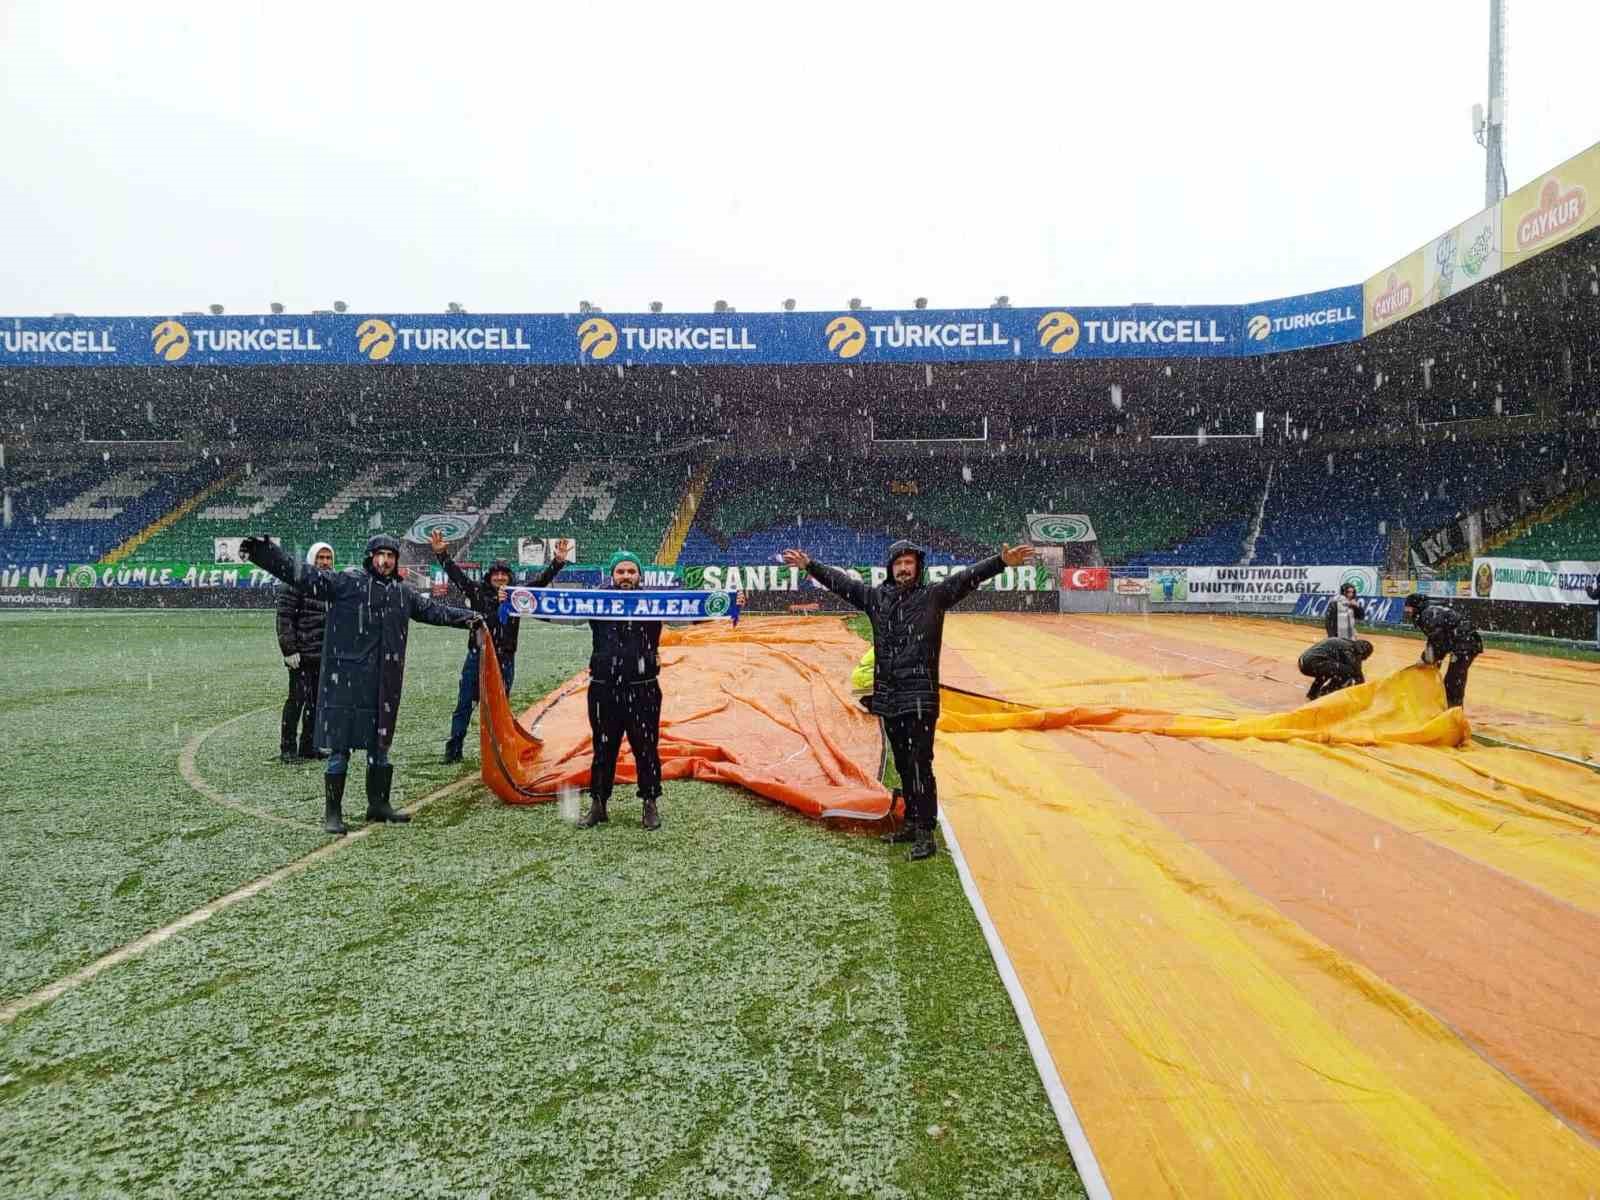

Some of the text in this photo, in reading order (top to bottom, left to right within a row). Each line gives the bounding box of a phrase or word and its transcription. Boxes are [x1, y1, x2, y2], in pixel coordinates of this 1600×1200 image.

[1271, 306, 1356, 331] TURKCELL
[0, 331, 116, 352] URKCELL
[193, 328, 322, 352] TURKCELL
[397, 328, 531, 351] TURKCELL
[622, 327, 756, 351] TURKCELL
[870, 323, 1009, 347] TURKCELL
[1084, 319, 1226, 344] TURKCELL
[1216, 568, 1309, 580] UNUTMADIK
[541, 592, 625, 616] CÜMLE
[633, 598, 700, 616] ALEM
